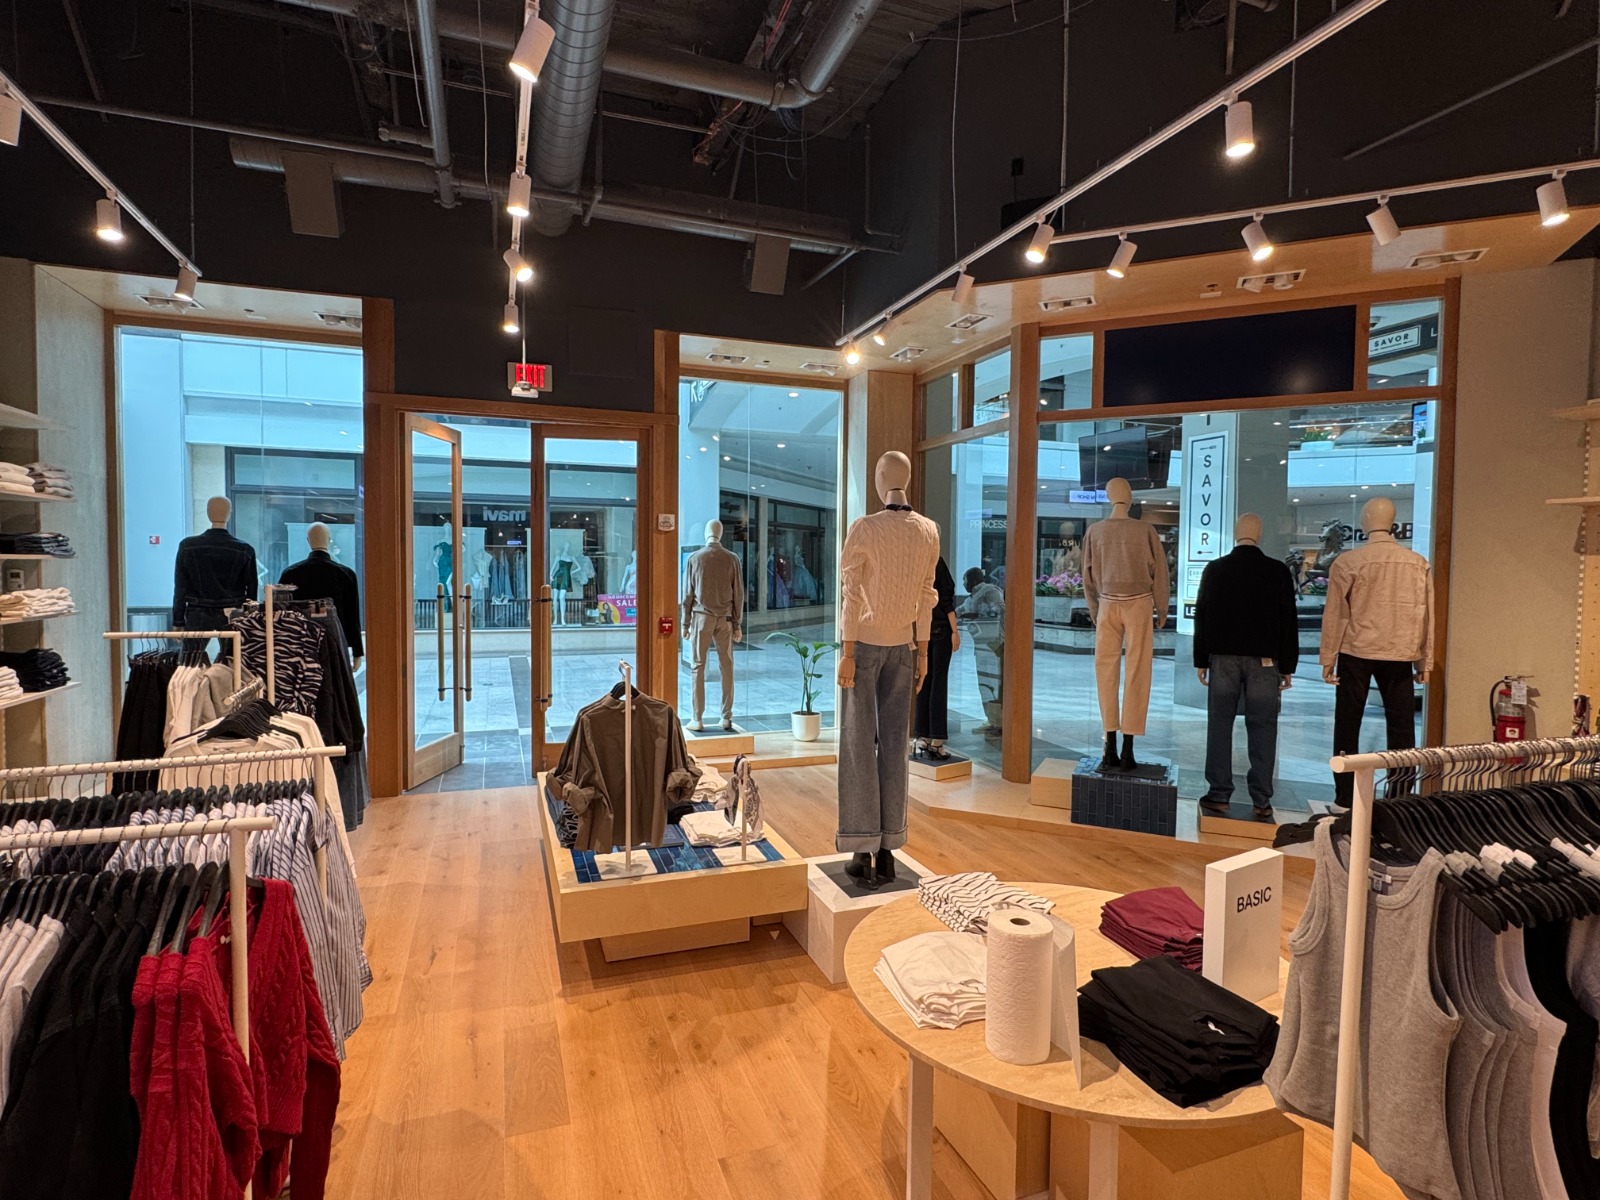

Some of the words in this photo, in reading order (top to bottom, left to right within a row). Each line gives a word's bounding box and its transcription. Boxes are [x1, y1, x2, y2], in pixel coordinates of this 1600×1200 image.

[1374, 333, 1409, 347] SAVOR
[515, 363, 546, 388] EXIT
[1200, 454, 1212, 546] SAVOR
[616, 599, 637, 607] SALE
[1237, 886, 1272, 913] BASIC
